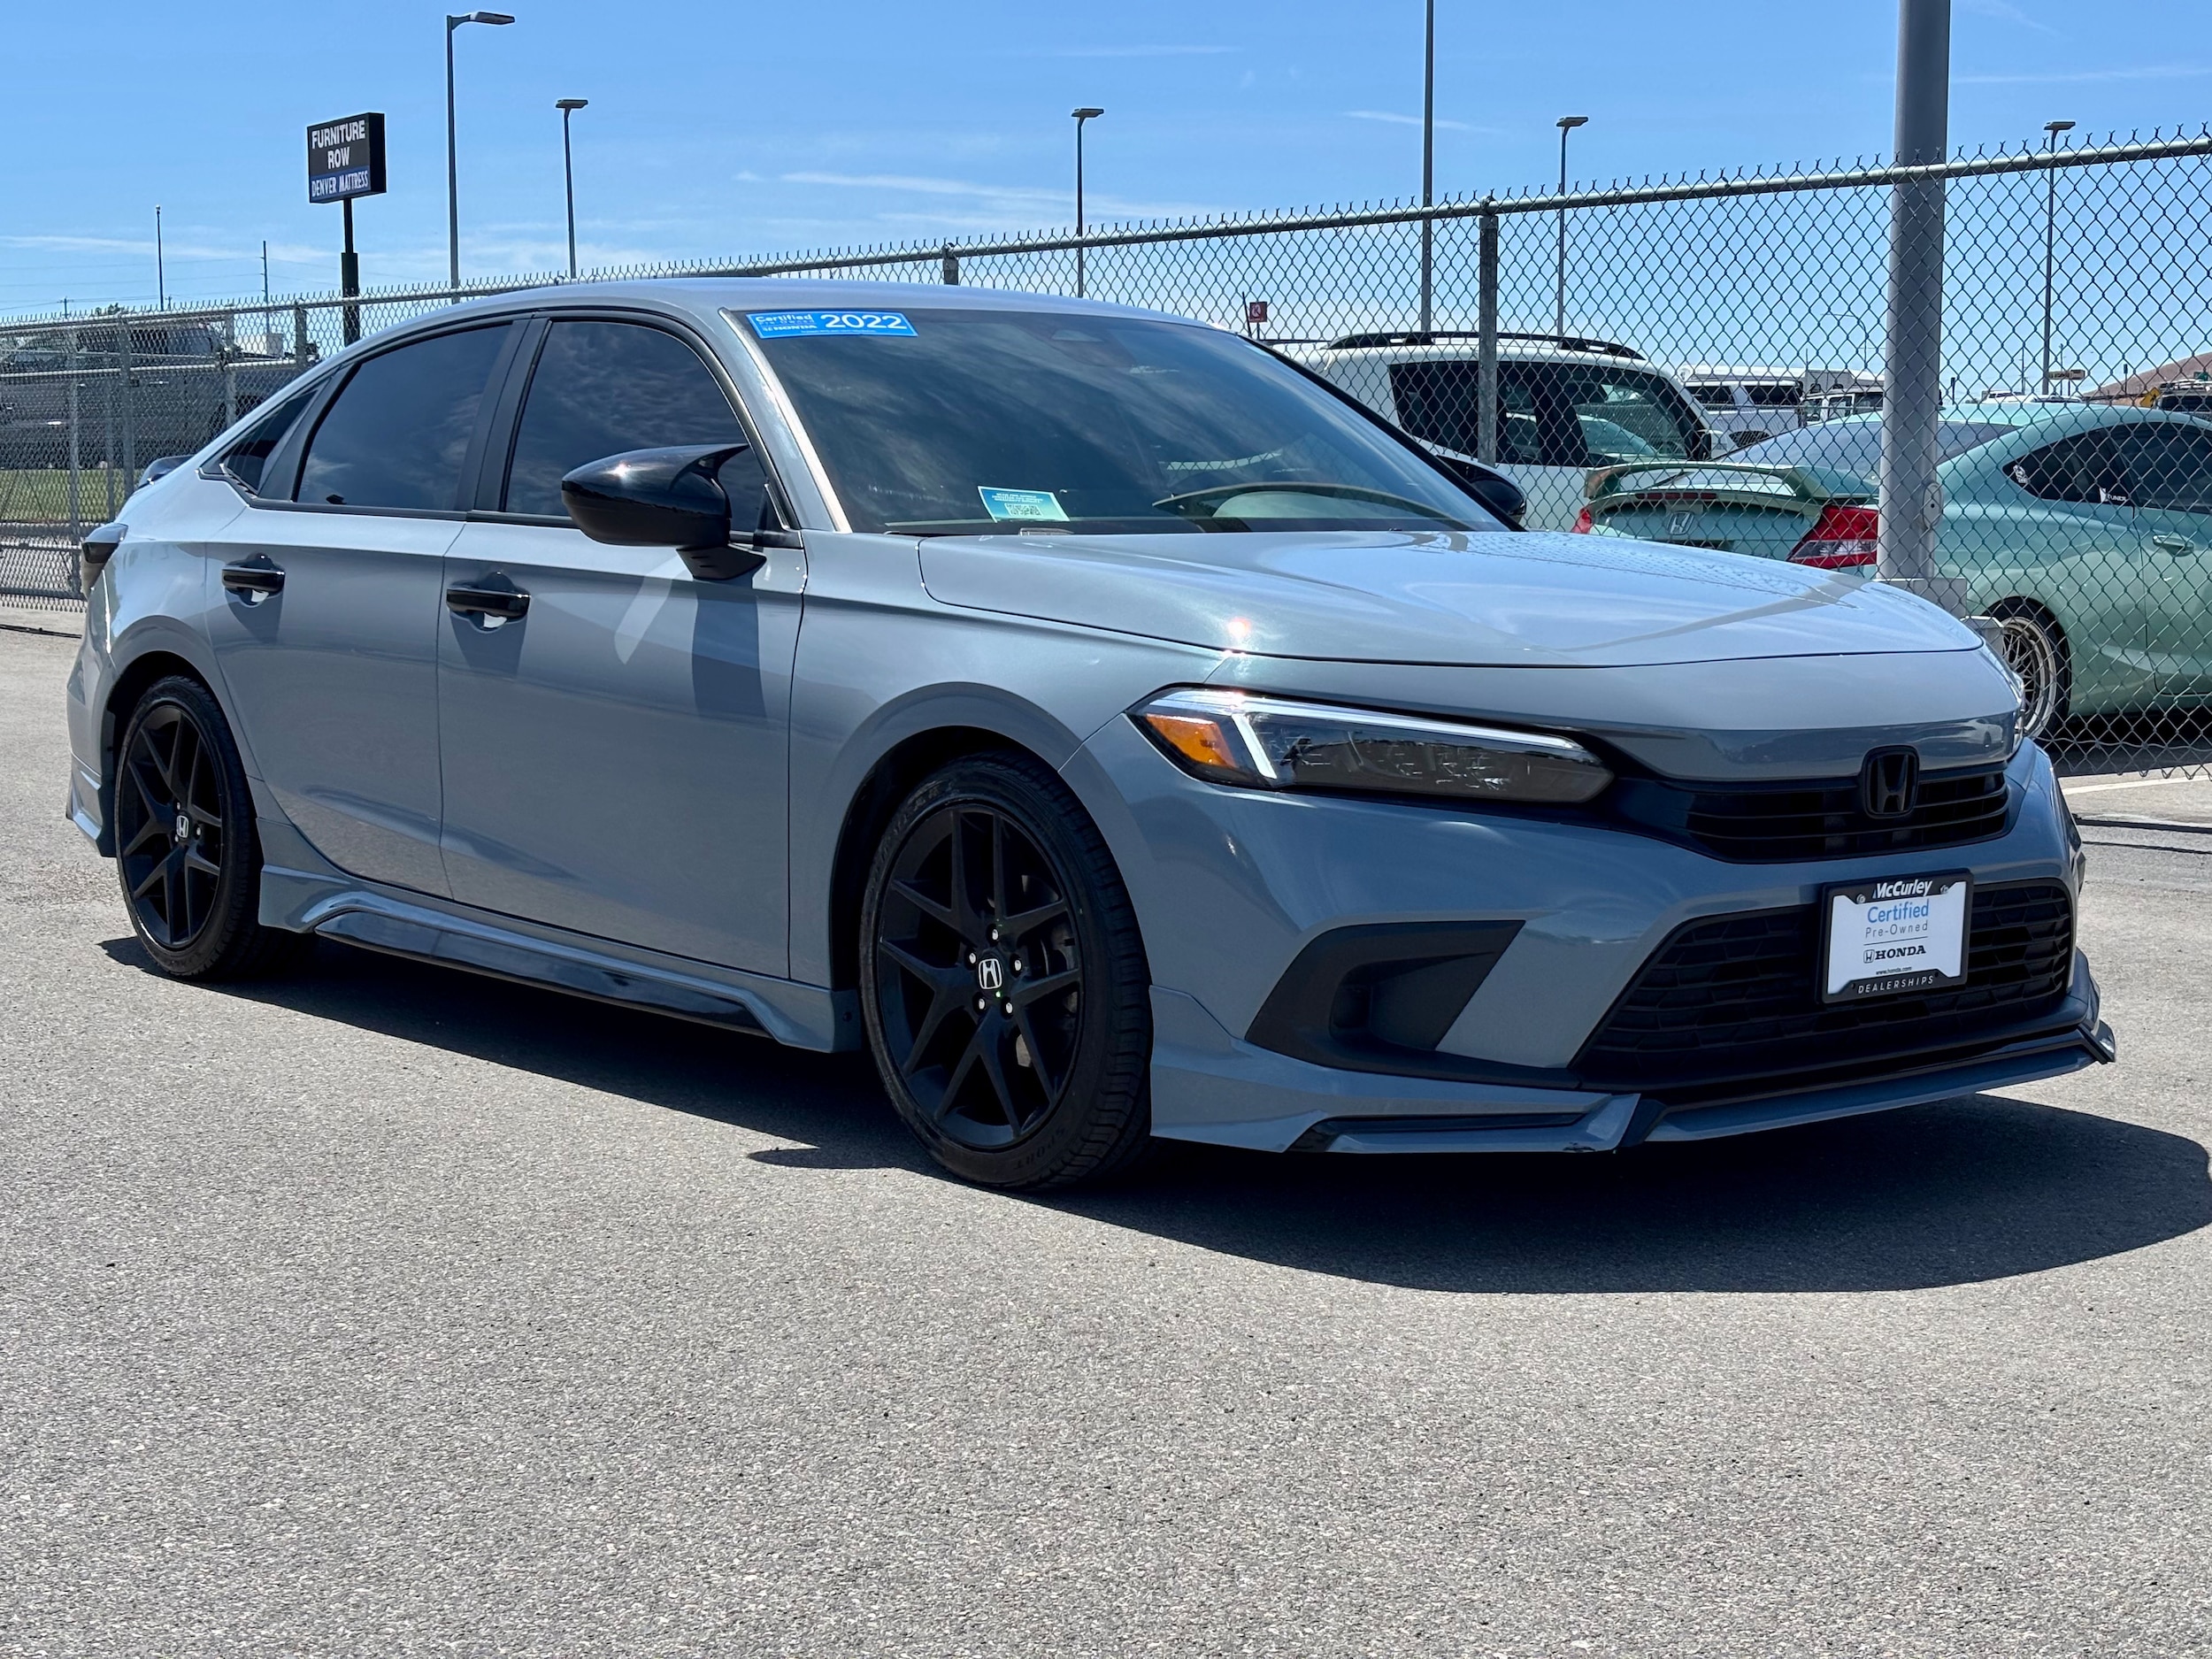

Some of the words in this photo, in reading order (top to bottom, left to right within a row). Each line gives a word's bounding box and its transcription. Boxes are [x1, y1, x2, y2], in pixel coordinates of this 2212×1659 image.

[311, 119, 366, 150] FURNITURE
[327, 146, 350, 170] ROW
[311, 177, 337, 197] DENVER
[339, 170, 369, 193] MATTRESS
[756, 313, 813, 323] Certified
[820, 313, 908, 330] 2022
[1873, 879, 1932, 900] McCurley
[1867, 899, 1930, 924] Certified
[1865, 920, 1928, 939] Pre-Owned
[1875, 945, 1926, 960] HONDA
[1875, 965, 1913, 976] www.honda.com
[1858, 975, 1934, 995] DEALERSHIPS
